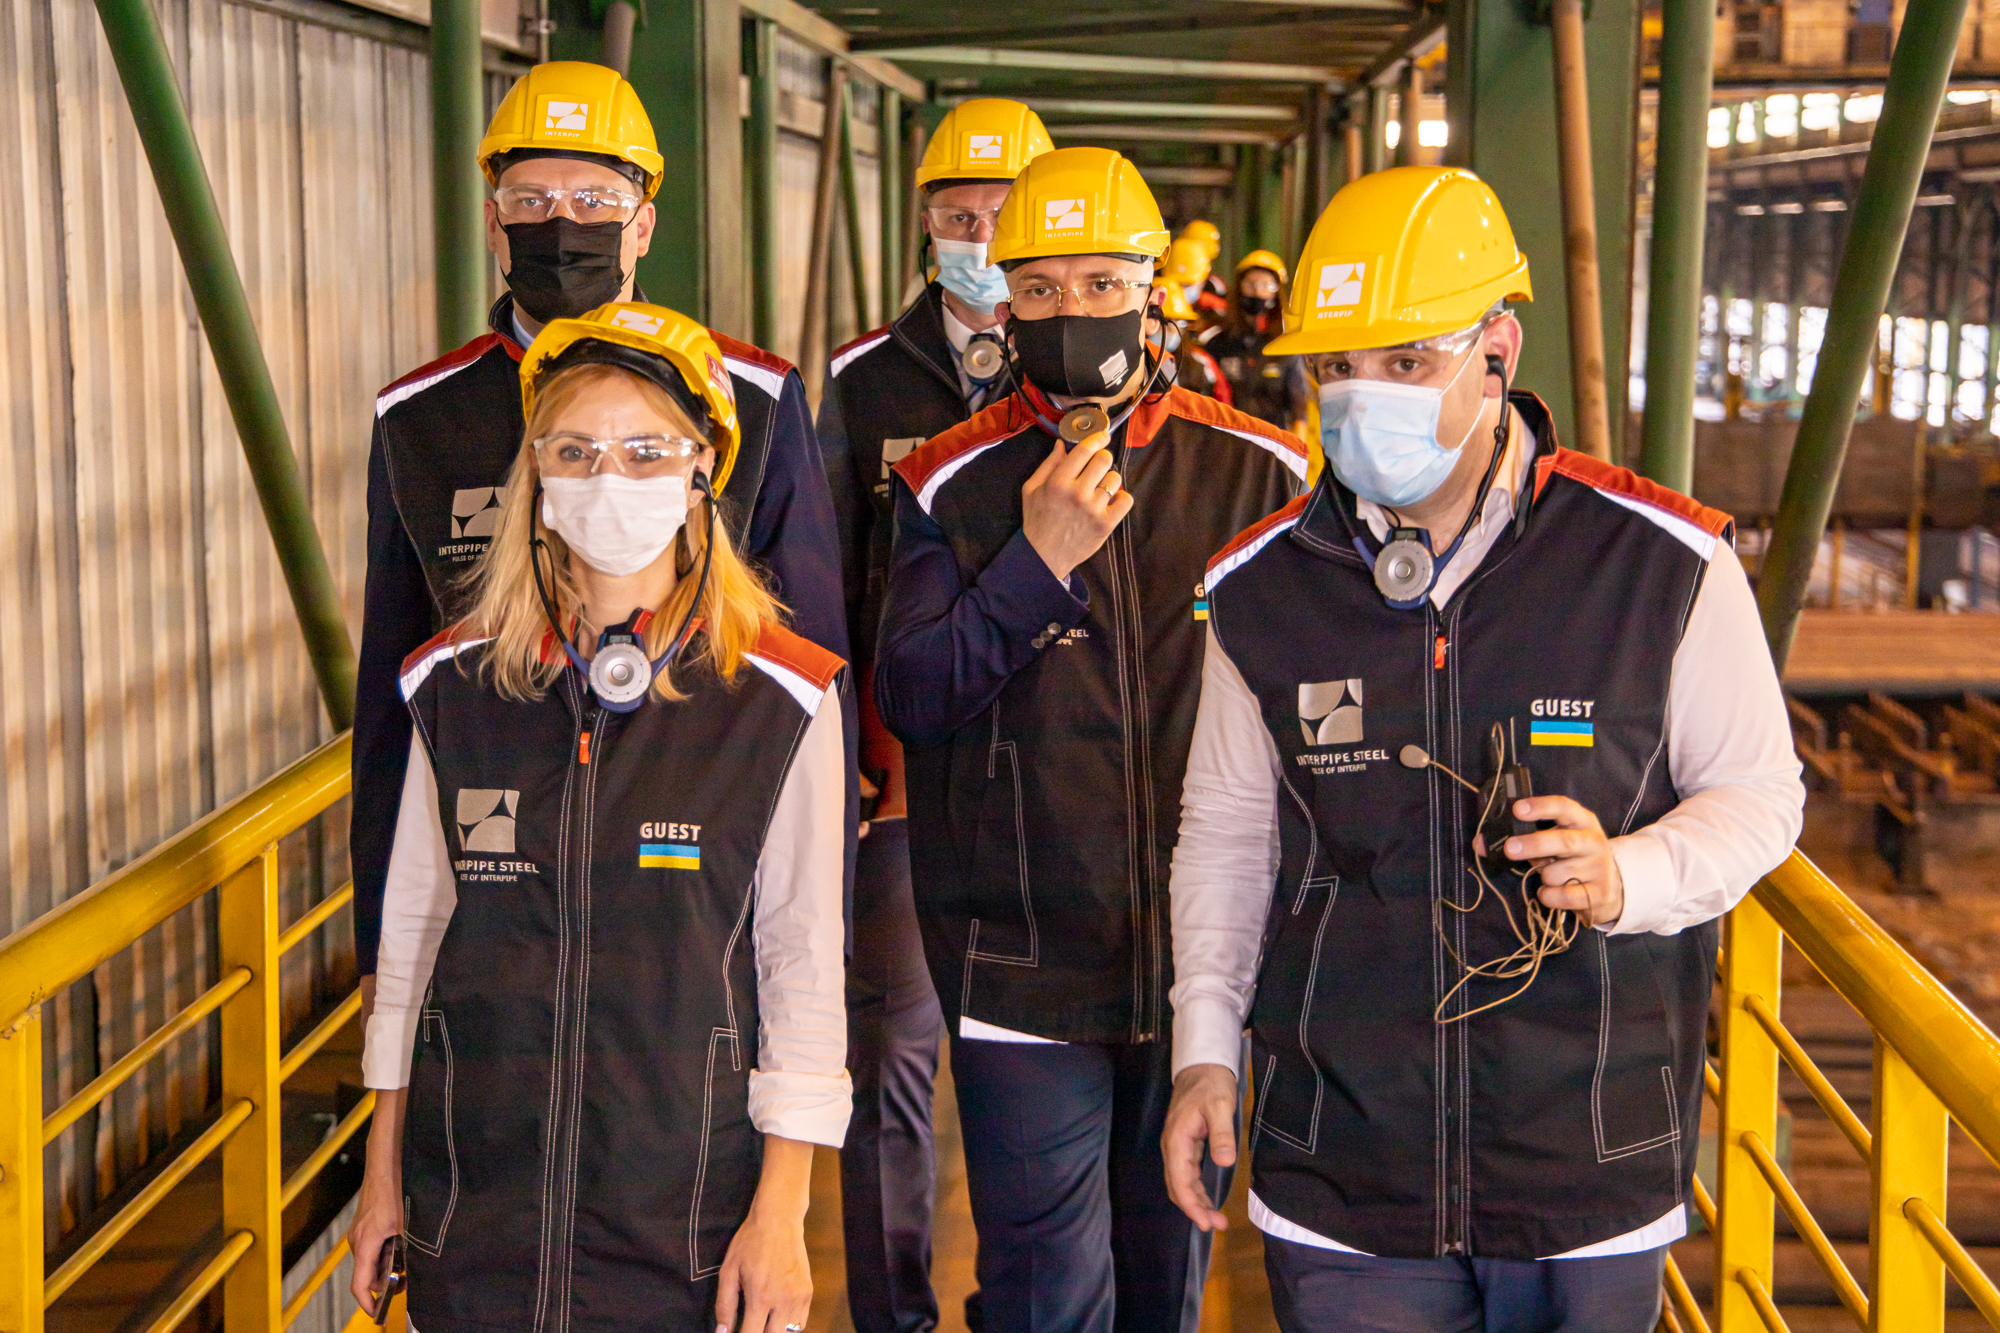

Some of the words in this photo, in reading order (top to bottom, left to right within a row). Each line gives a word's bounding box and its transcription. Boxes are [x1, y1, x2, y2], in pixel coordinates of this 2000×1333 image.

[438, 543, 488, 556] INTERPIPE
[1531, 699, 1594, 718] GUEST
[1296, 753, 1350, 766] INTERPIPE
[1353, 749, 1390, 762] STEEL
[1326, 767, 1335, 775] OF
[640, 822, 701, 841] GUEST
[499, 861, 539, 873] STEEL
[480, 874, 517, 882] INTERPIPE
